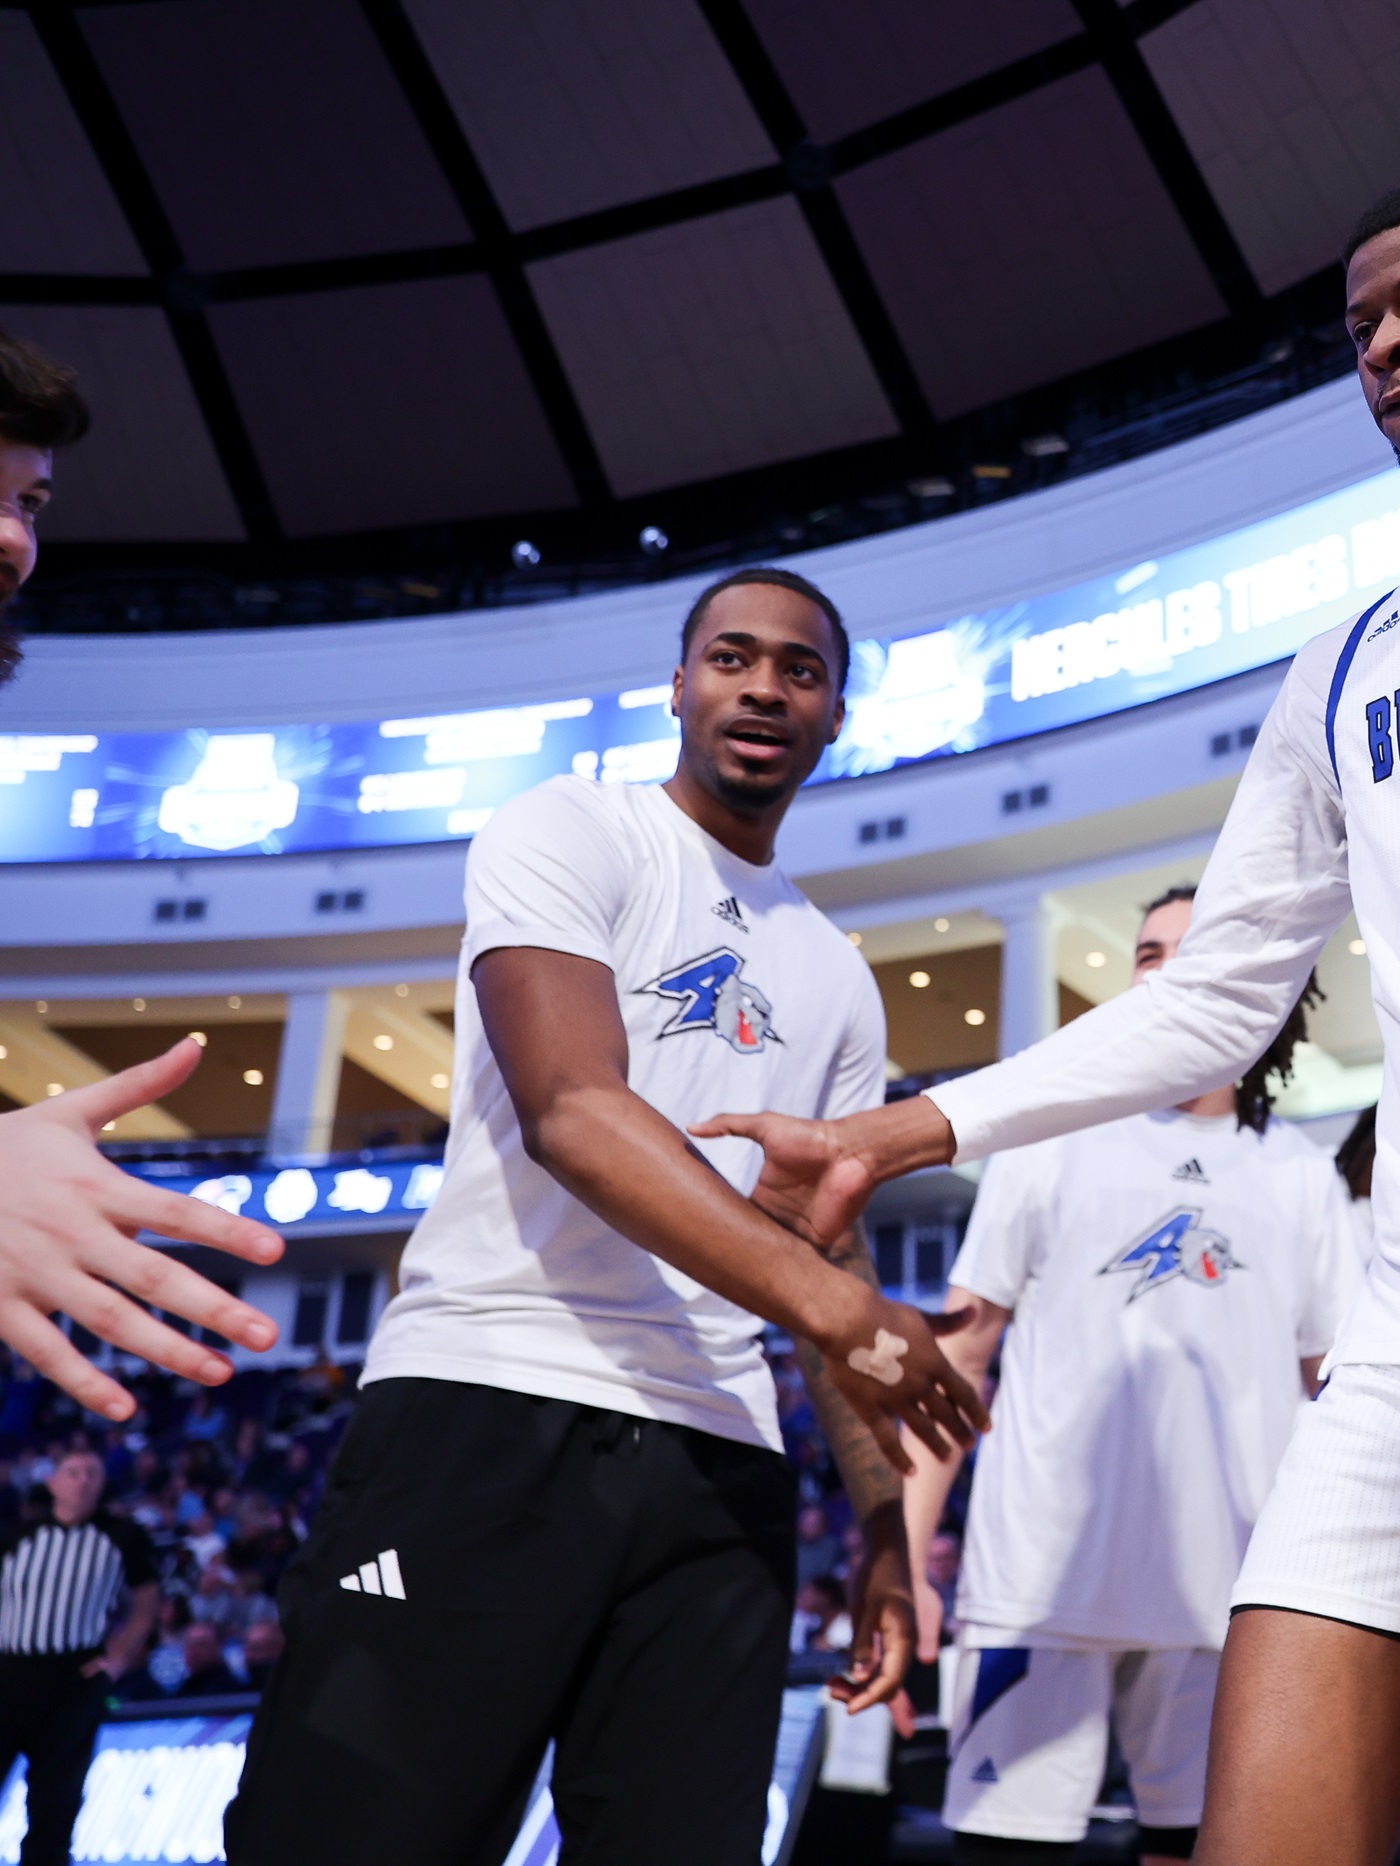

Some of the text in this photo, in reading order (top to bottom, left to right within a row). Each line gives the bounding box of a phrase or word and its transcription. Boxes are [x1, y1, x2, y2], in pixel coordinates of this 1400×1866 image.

[1010, 580, 1222, 702] HERCULES
[1223, 534, 1349, 634] TIRES
[711, 905, 750, 934] adidas
